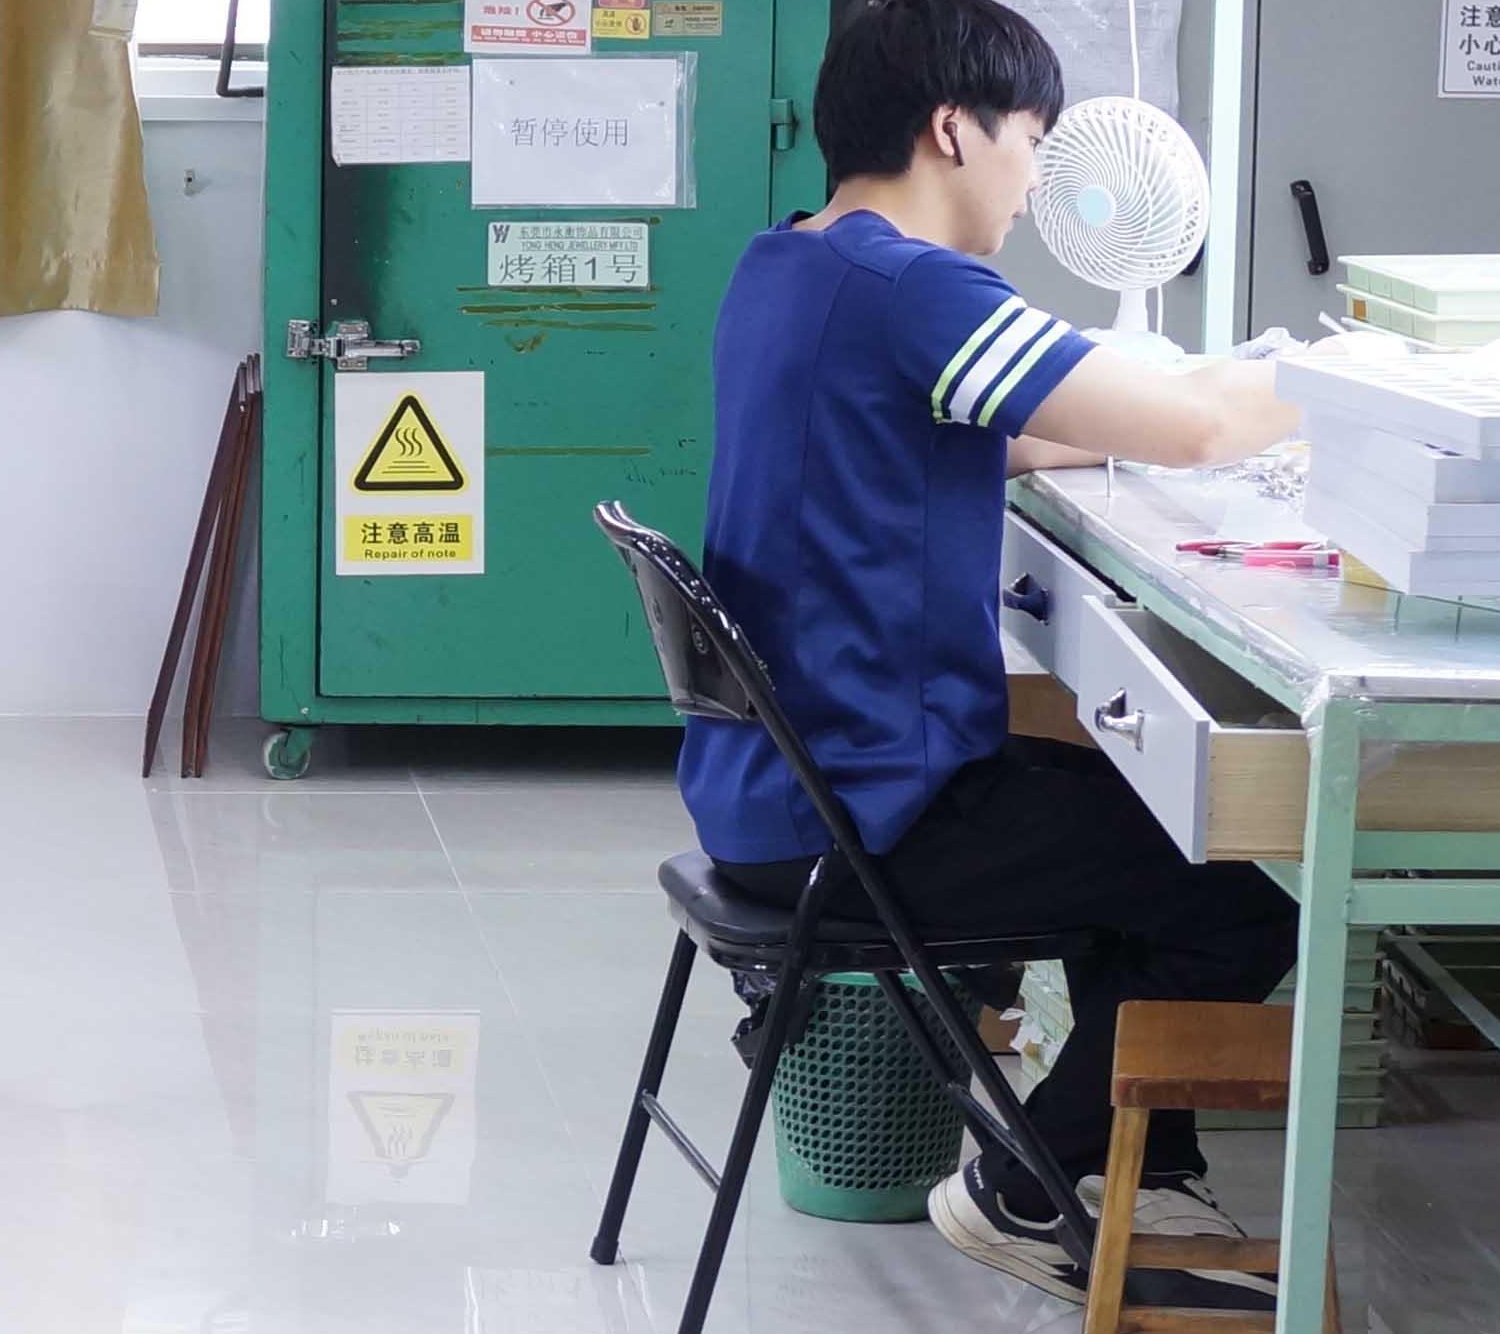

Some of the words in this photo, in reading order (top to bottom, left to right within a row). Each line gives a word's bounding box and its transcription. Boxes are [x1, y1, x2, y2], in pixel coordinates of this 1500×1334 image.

[510, 119, 630, 148] 暂停使用
[498, 253, 643, 284] 烤箱1号
[361, 522, 461, 545] 注意高温
[364, 548, 407, 561] Repair
[411, 548, 424, 559] of
[428, 549, 457, 559] note
